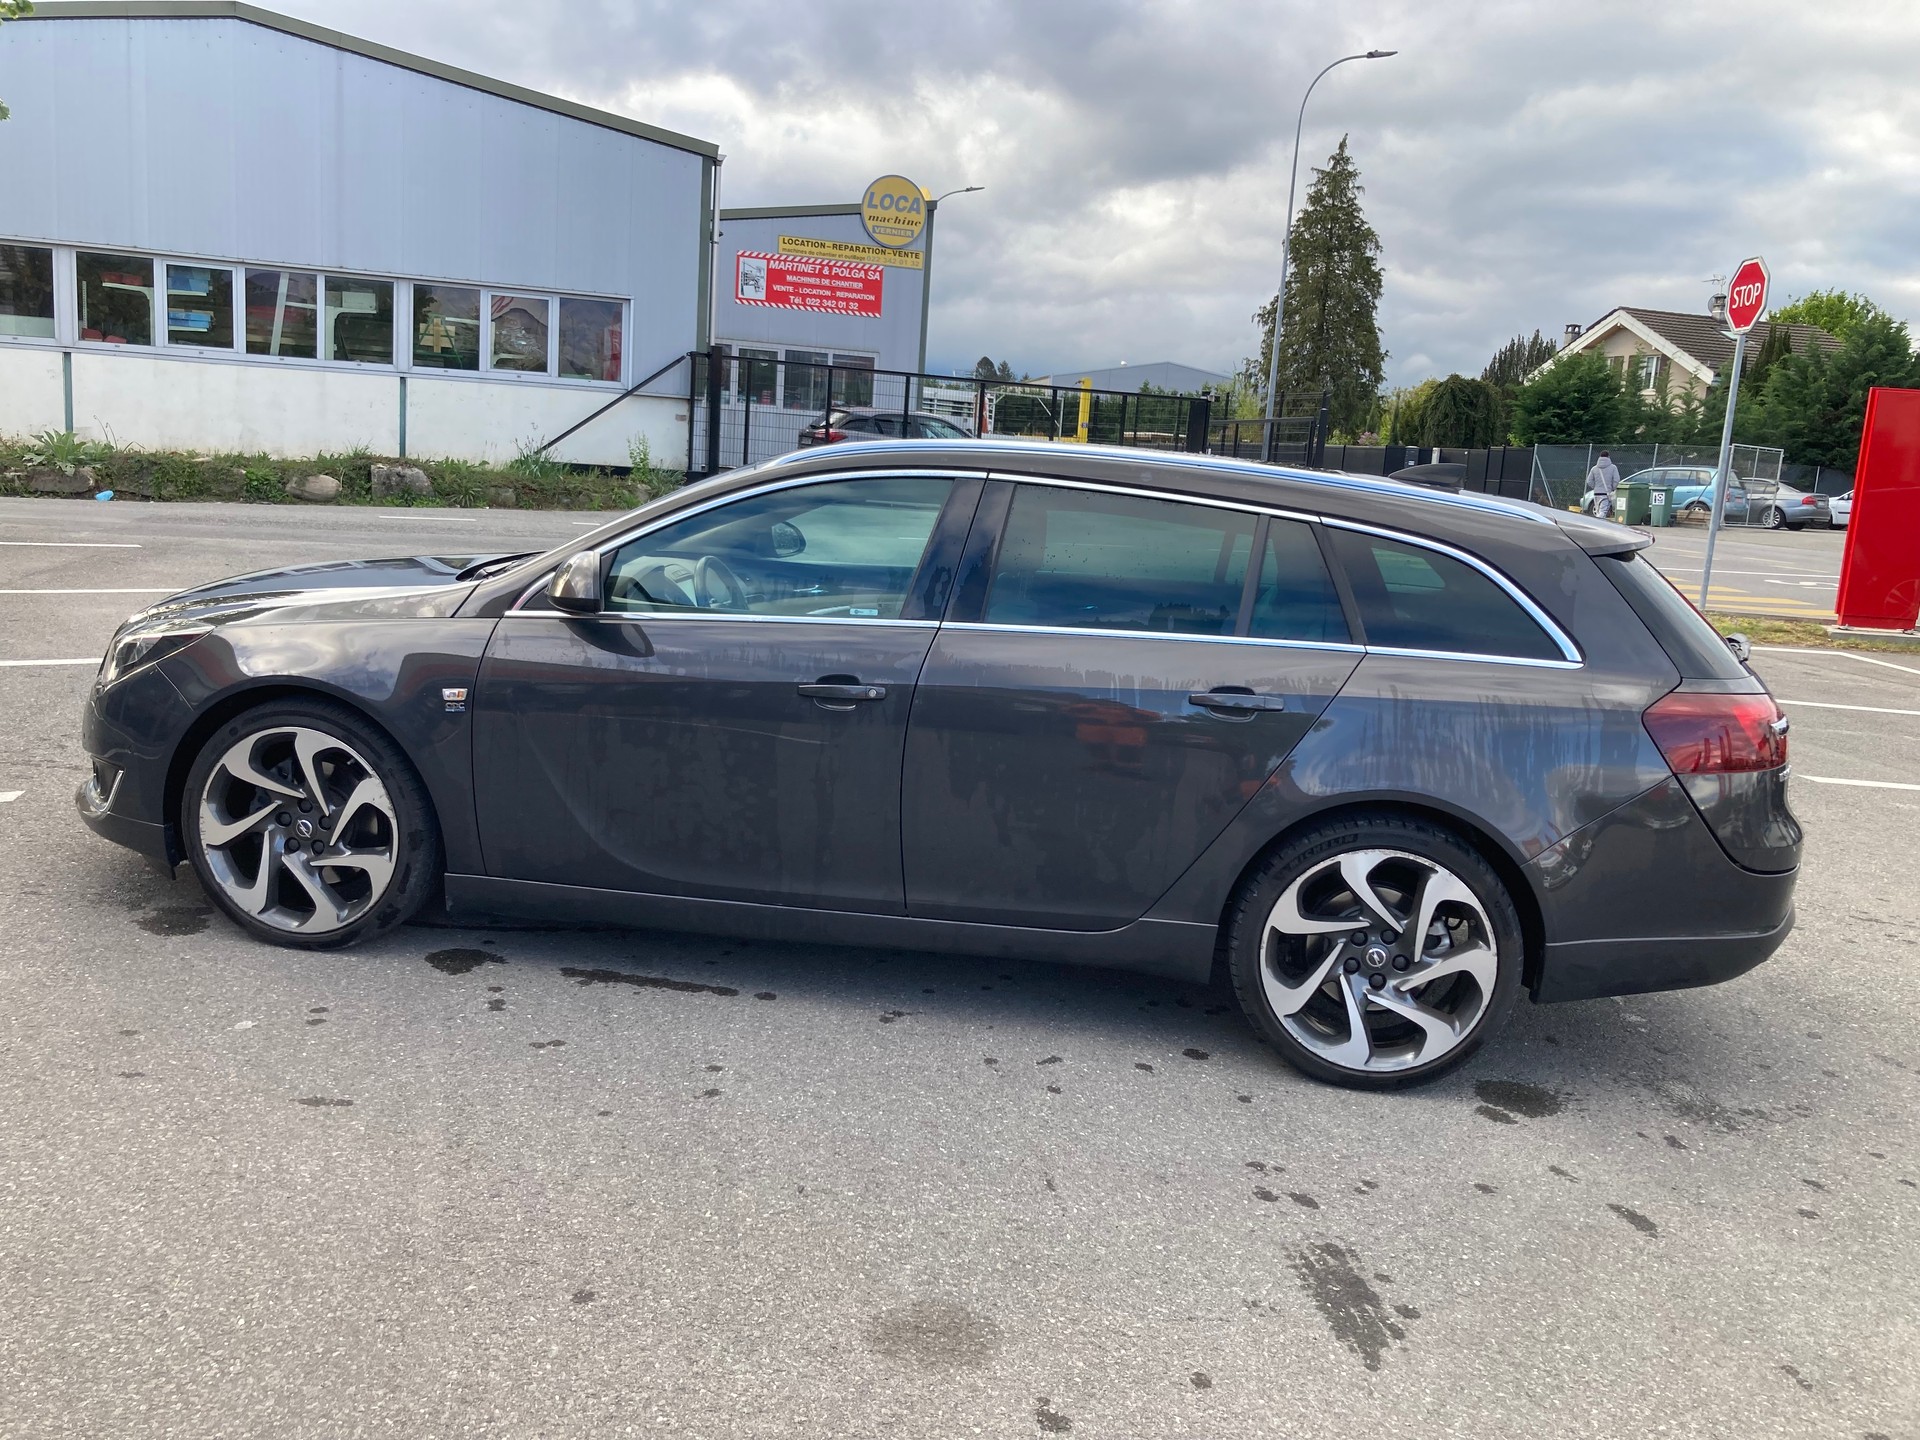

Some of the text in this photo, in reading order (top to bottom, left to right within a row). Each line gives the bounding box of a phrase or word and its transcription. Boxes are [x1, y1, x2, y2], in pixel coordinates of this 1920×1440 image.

[867, 192, 921, 214] LOCA
[868, 215, 921, 227] machine
[874, 226, 912, 237] VERNIER
[782, 247, 807, 256] machines
[816, 250, 837, 258] chantier
[769, 260, 880, 281] MARTINET & POLGA SA
[786, 275, 863, 289] MACHINES DE CHANTIER
[772, 284, 794, 293] VENTE
[799, 287, 831, 297] LOCATION
[836, 292, 875, 301] REPARATION
[1732, 283, 1761, 309] STOP
[789, 295, 859, 310] Tél. 022 342 01 32
